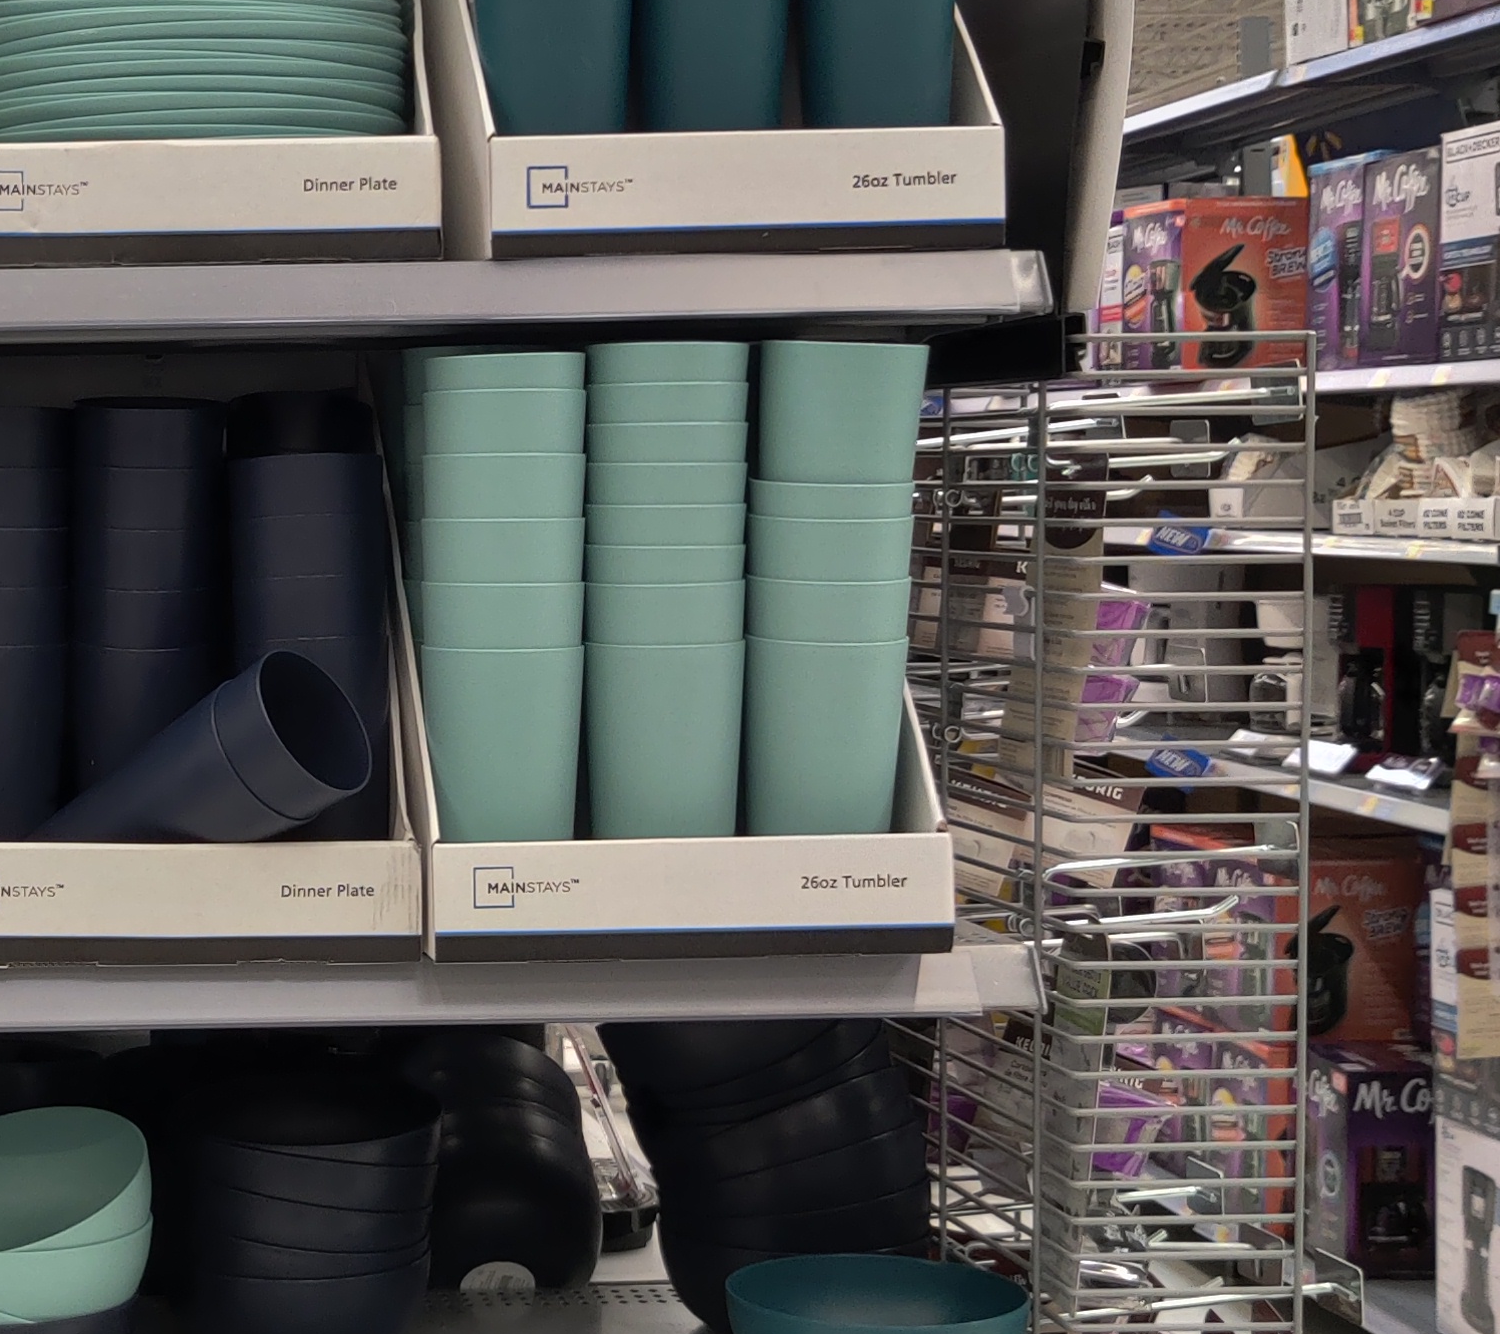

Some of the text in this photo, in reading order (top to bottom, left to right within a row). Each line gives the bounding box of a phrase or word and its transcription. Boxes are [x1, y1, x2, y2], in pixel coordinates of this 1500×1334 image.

[303, 176, 397, 193] Dinner Plate
[852, 171, 957, 189] 26oz Tumbler
[1155, 526, 1191, 547] NEW
[801, 873, 908, 890] 26oz Tumbler
[281, 883, 375, 899] Dinner Plate
